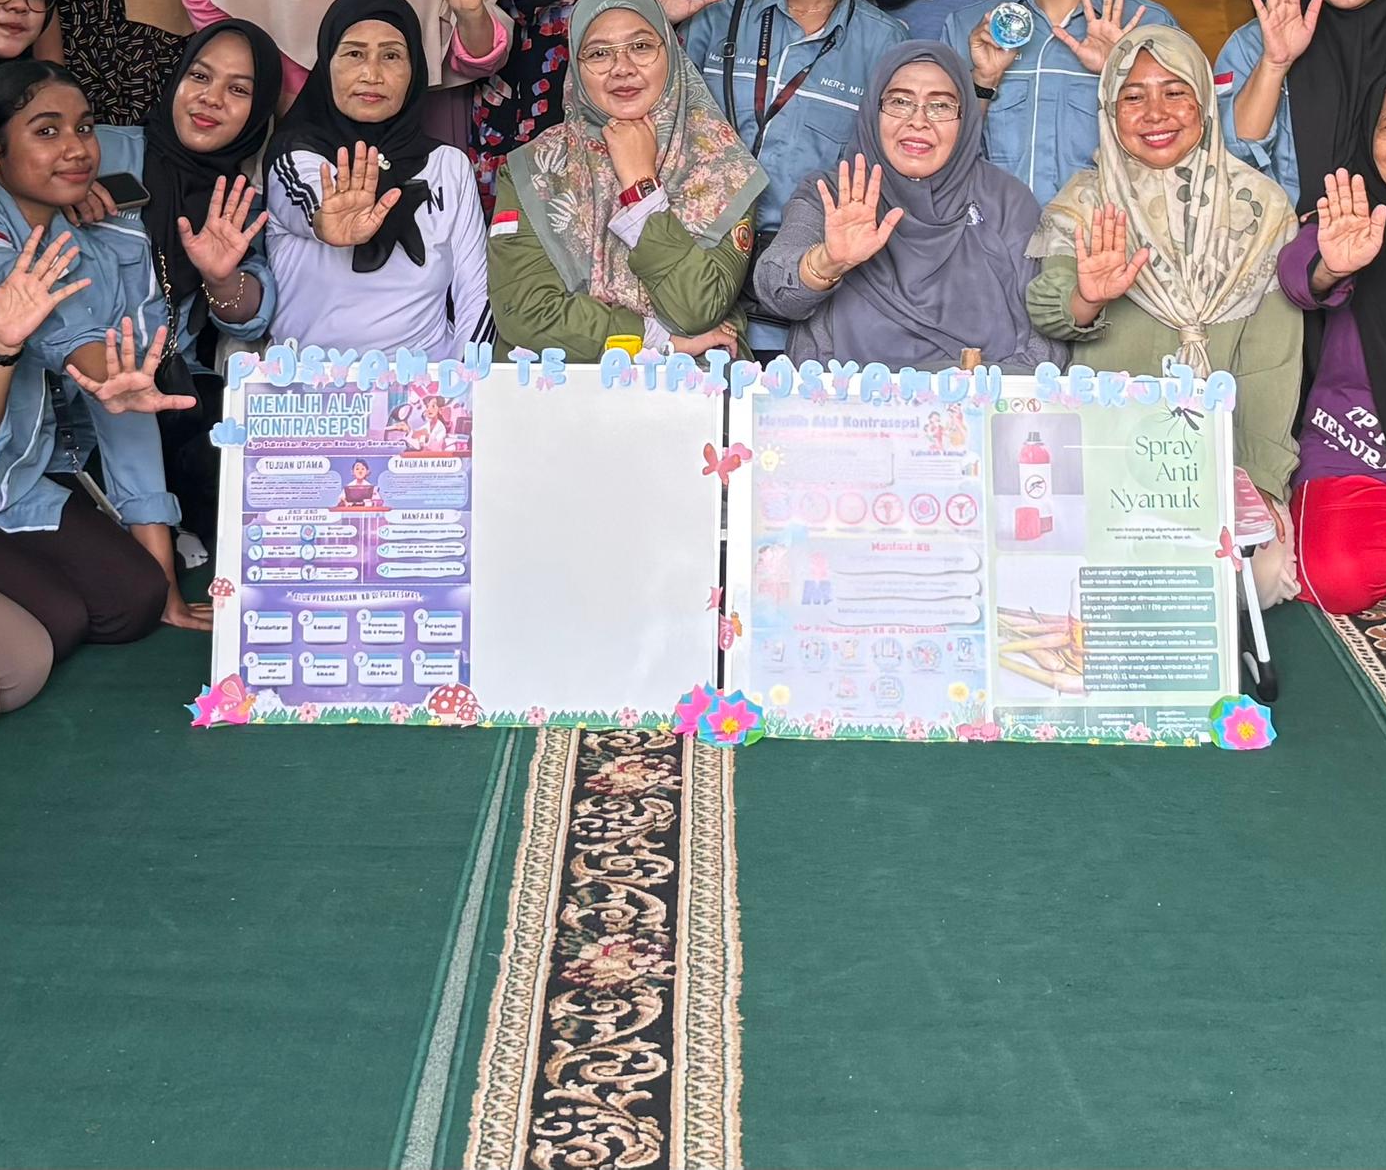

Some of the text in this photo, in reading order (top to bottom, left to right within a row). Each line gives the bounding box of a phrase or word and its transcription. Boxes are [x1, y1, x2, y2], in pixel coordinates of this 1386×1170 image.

[820, 77, 864, 96] NERS MU
[228, 341, 493, 398] POSYANDU
[730, 354, 1002, 403] POSYANDU
[247, 392, 375, 416] MEMILIH ALAT
[247, 415, 370, 438] KONTRASEPSI
[842, 415, 921, 430] Kontrasepsi
[1135, 435, 1198, 462] Spray
[296, 460, 324, 470] UTAMA
[1155, 461, 1198, 482] Anti
[1110, 486, 1200, 513] Nyamuk
